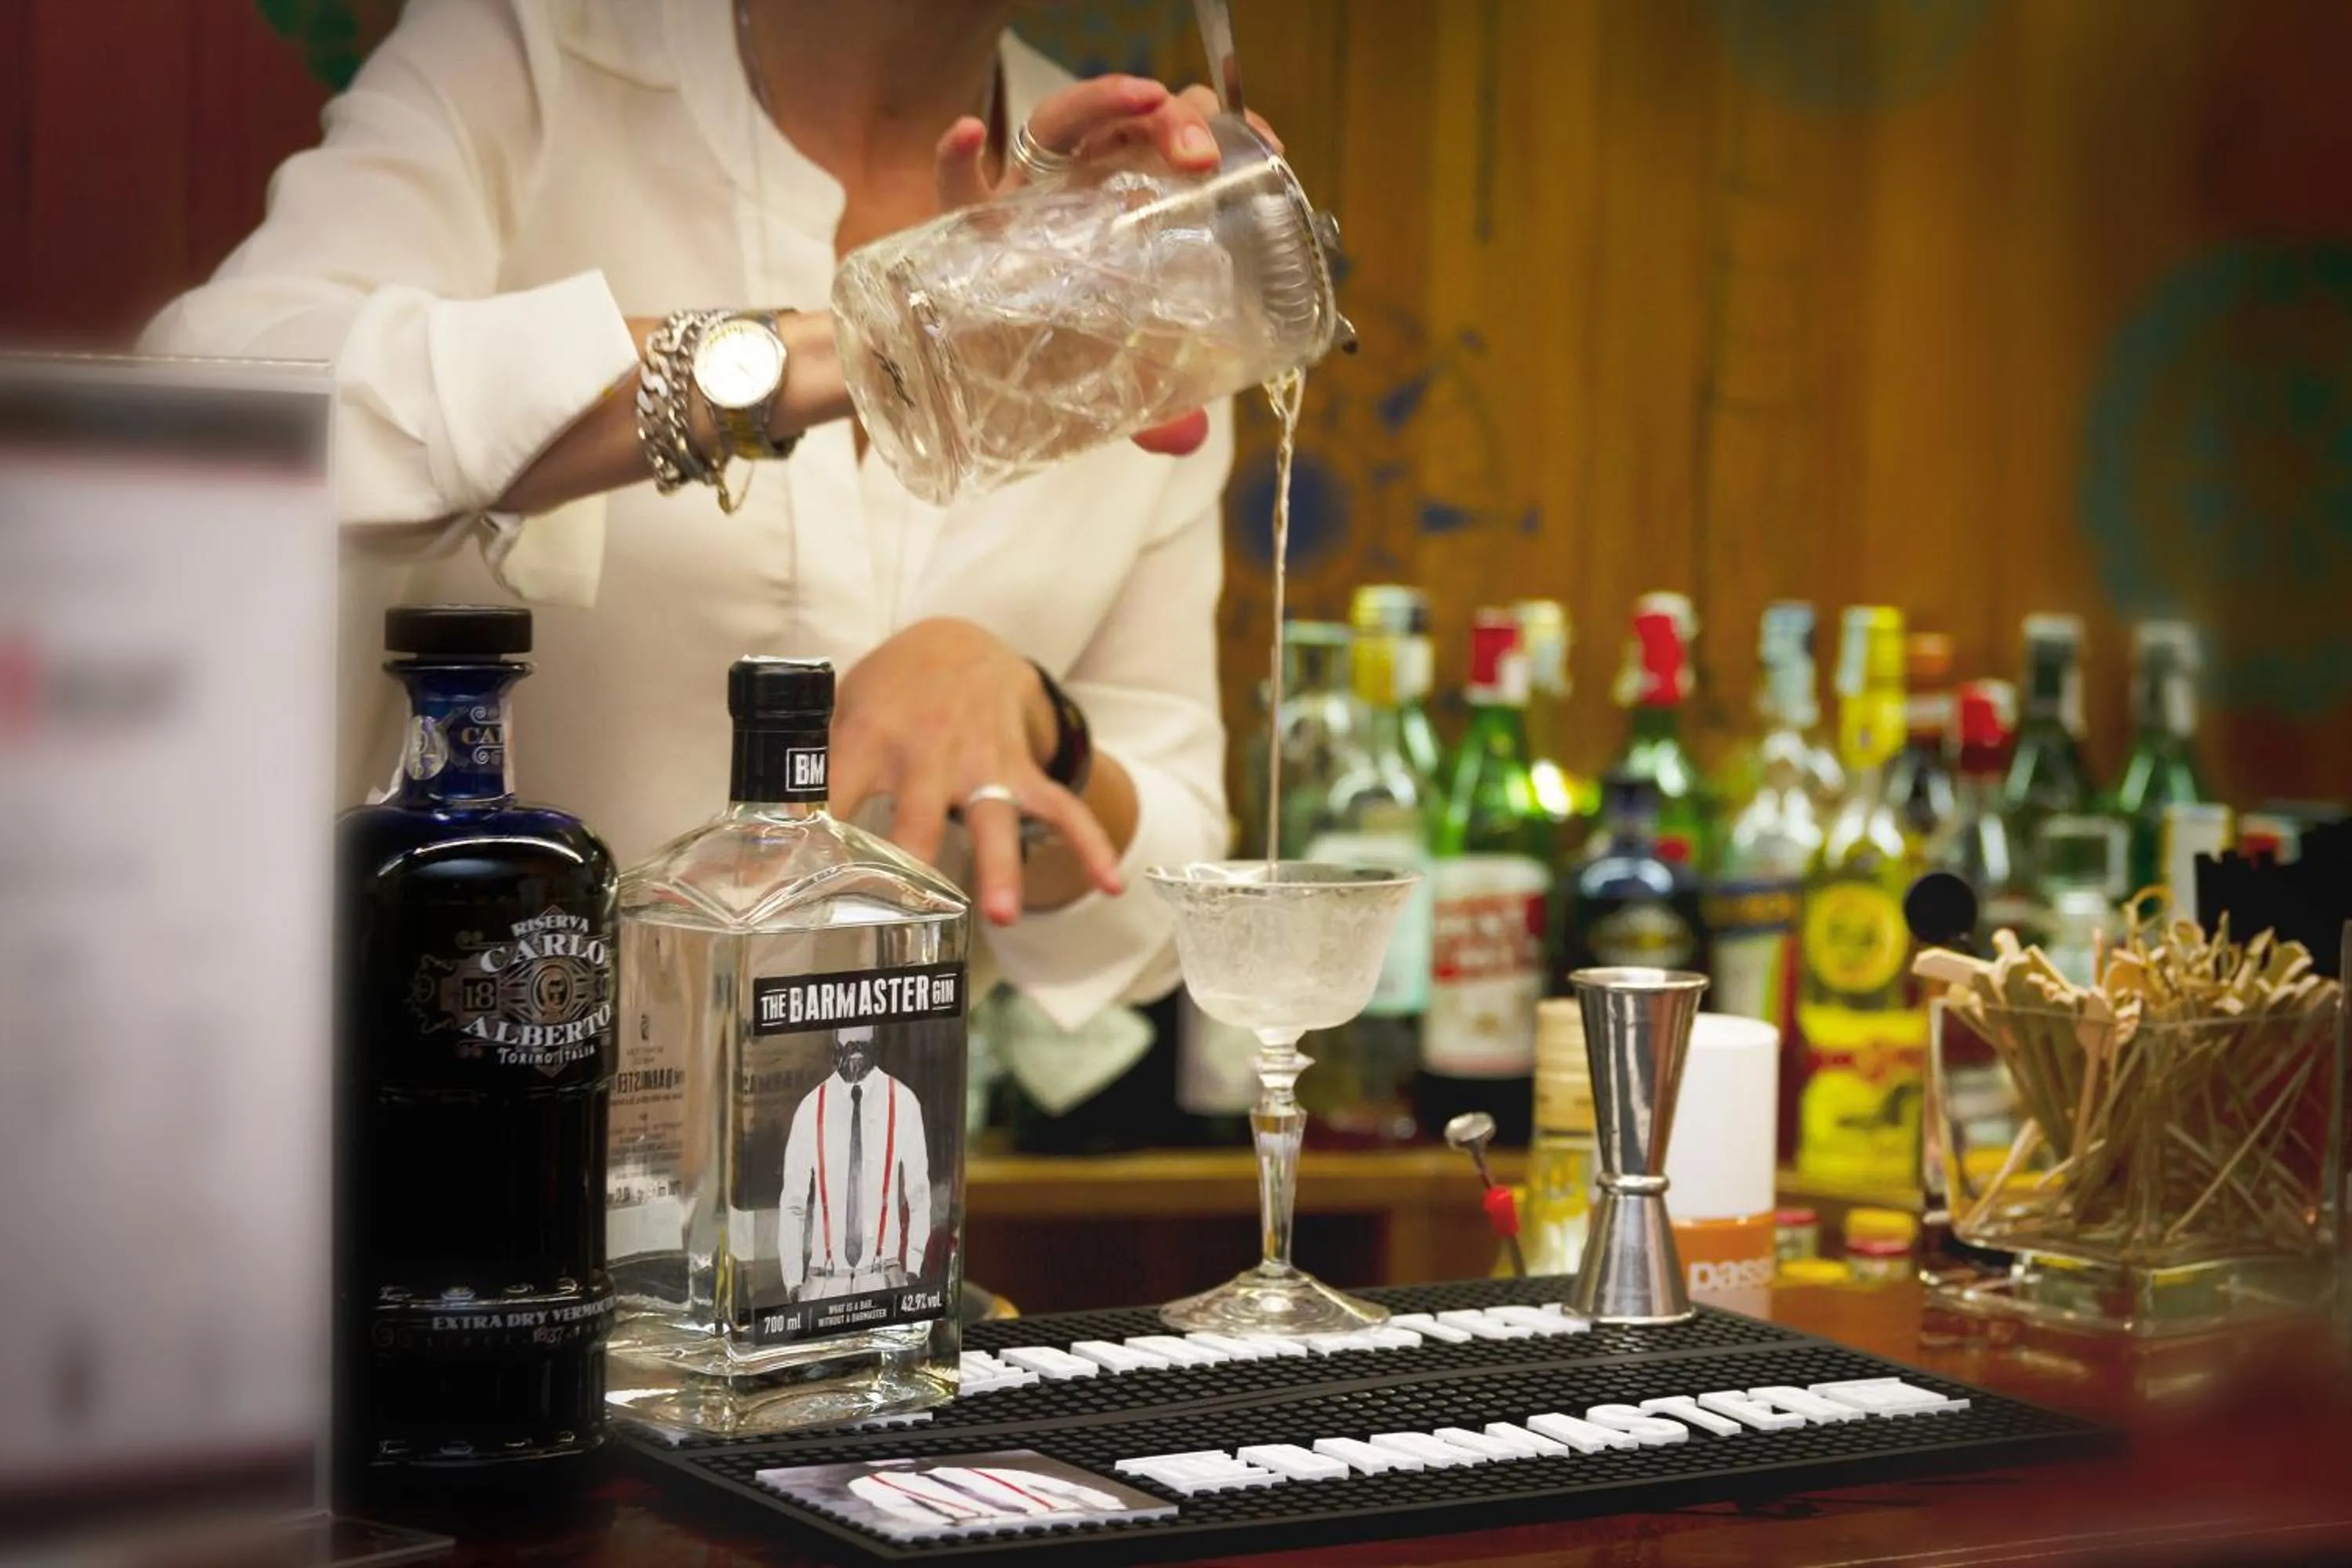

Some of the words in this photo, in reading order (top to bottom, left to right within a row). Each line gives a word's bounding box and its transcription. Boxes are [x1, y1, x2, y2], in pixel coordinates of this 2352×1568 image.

[795, 753, 826, 785] BM
[511, 915, 589, 937] RISERVA
[480, 933, 606, 973] CARLO
[760, 993, 786, 1020] THE
[789, 975, 929, 1023] BARMASTER
[932, 979, 954, 1004] GIN
[461, 1004, 611, 1047] ALBERTO
[432, 1315, 503, 1330] EXTRA
[507, 1311, 548, 1328] DRY
[764, 1315, 784, 1334] 700
[787, 1312, 800, 1330] ml
